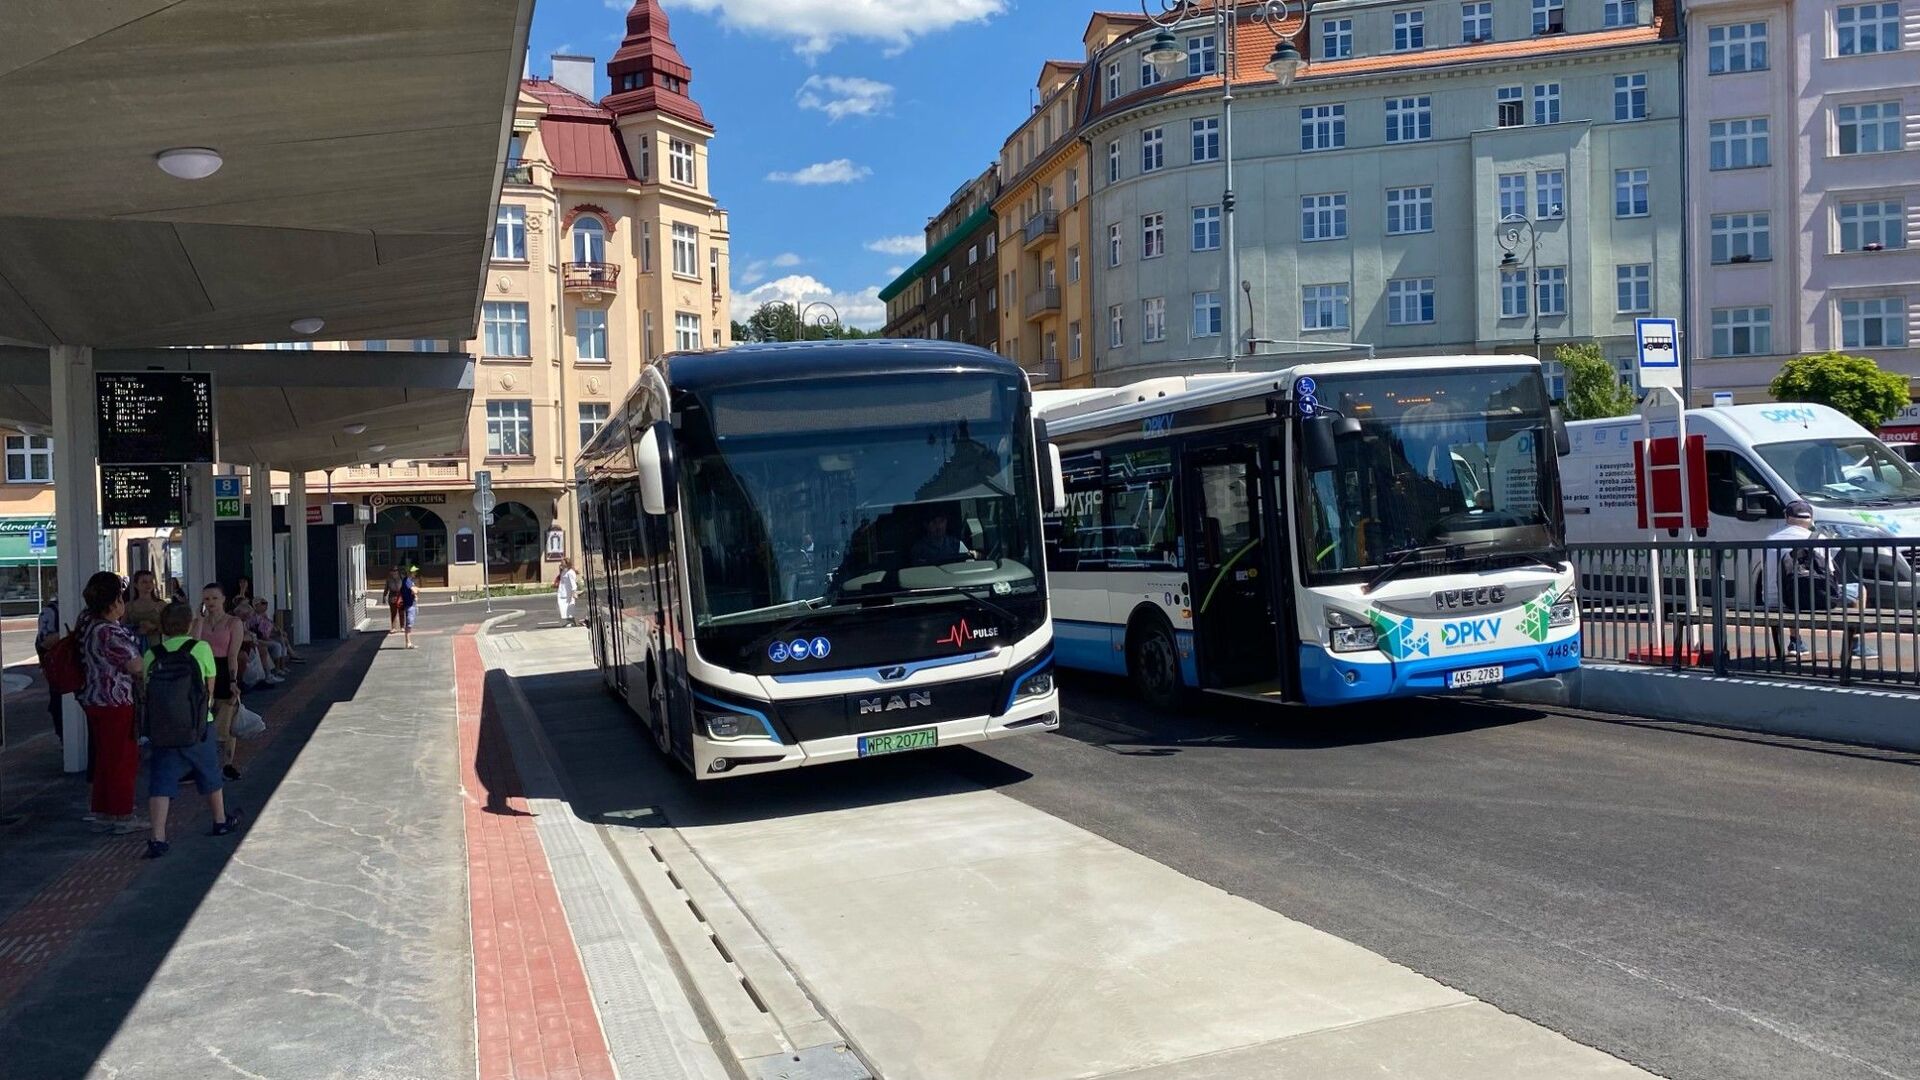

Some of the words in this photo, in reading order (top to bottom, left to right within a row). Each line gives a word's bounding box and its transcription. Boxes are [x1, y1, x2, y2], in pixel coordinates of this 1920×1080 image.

[222, 480, 232, 490] 8
[218, 501, 239, 512] 148
[33, 531, 43, 542] P
[1436, 585, 1505, 610] IVECO
[973, 627, 999, 639] PULSE
[1441, 618, 1501, 645] DPKV
[1454, 671, 1472, 684] 4K5
[1478, 668, 1500, 680] 2783
[860, 691, 931, 714] MAN
[867, 737, 891, 753] WPR
[896, 731, 934, 748] 2077H
